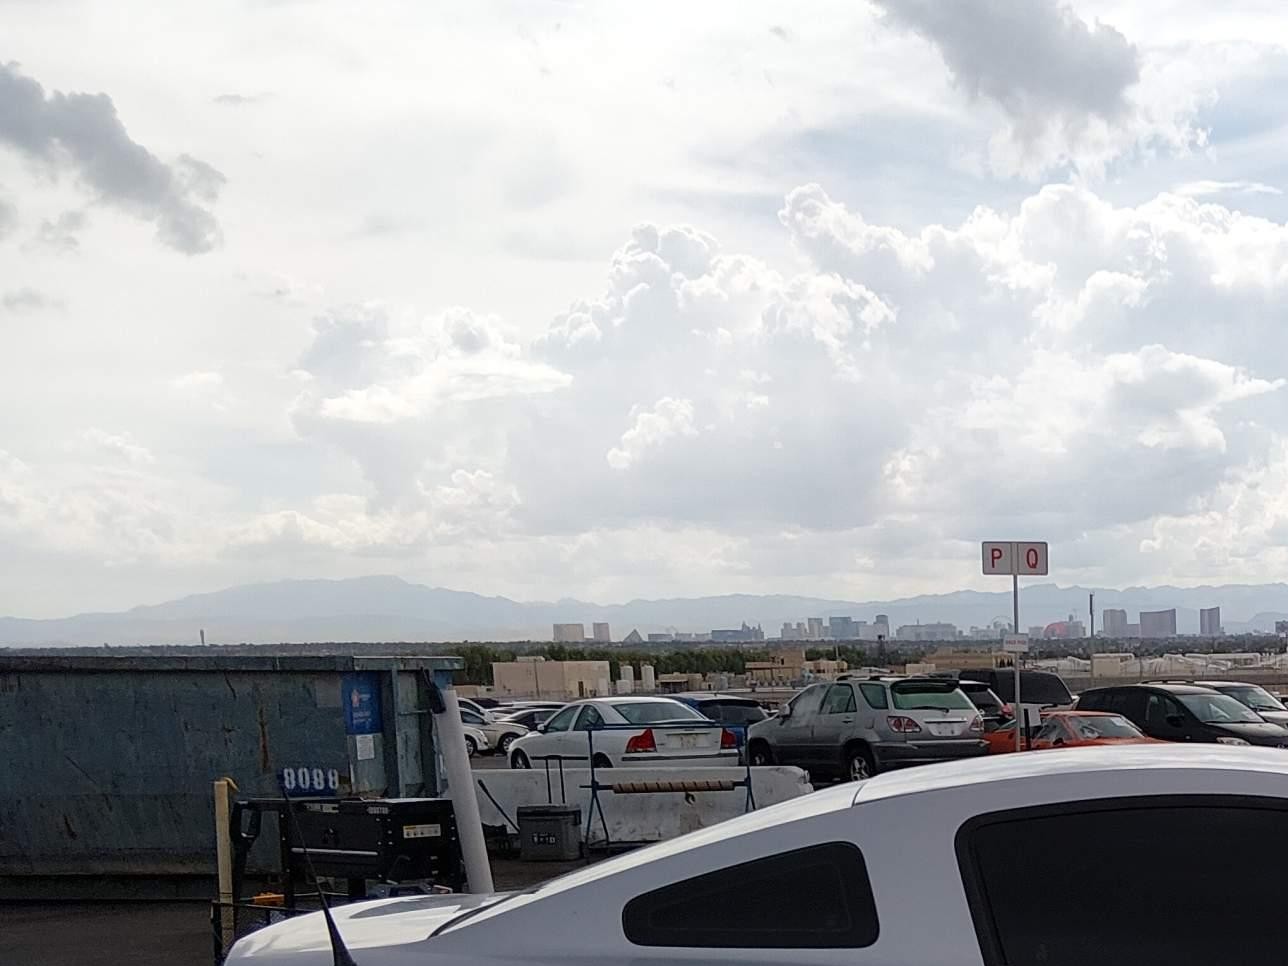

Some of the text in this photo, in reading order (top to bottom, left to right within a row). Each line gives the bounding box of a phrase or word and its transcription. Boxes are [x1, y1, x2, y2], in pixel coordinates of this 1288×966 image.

[991, 548, 1039, 569] P Q
[283, 767, 339, 790] 8088
